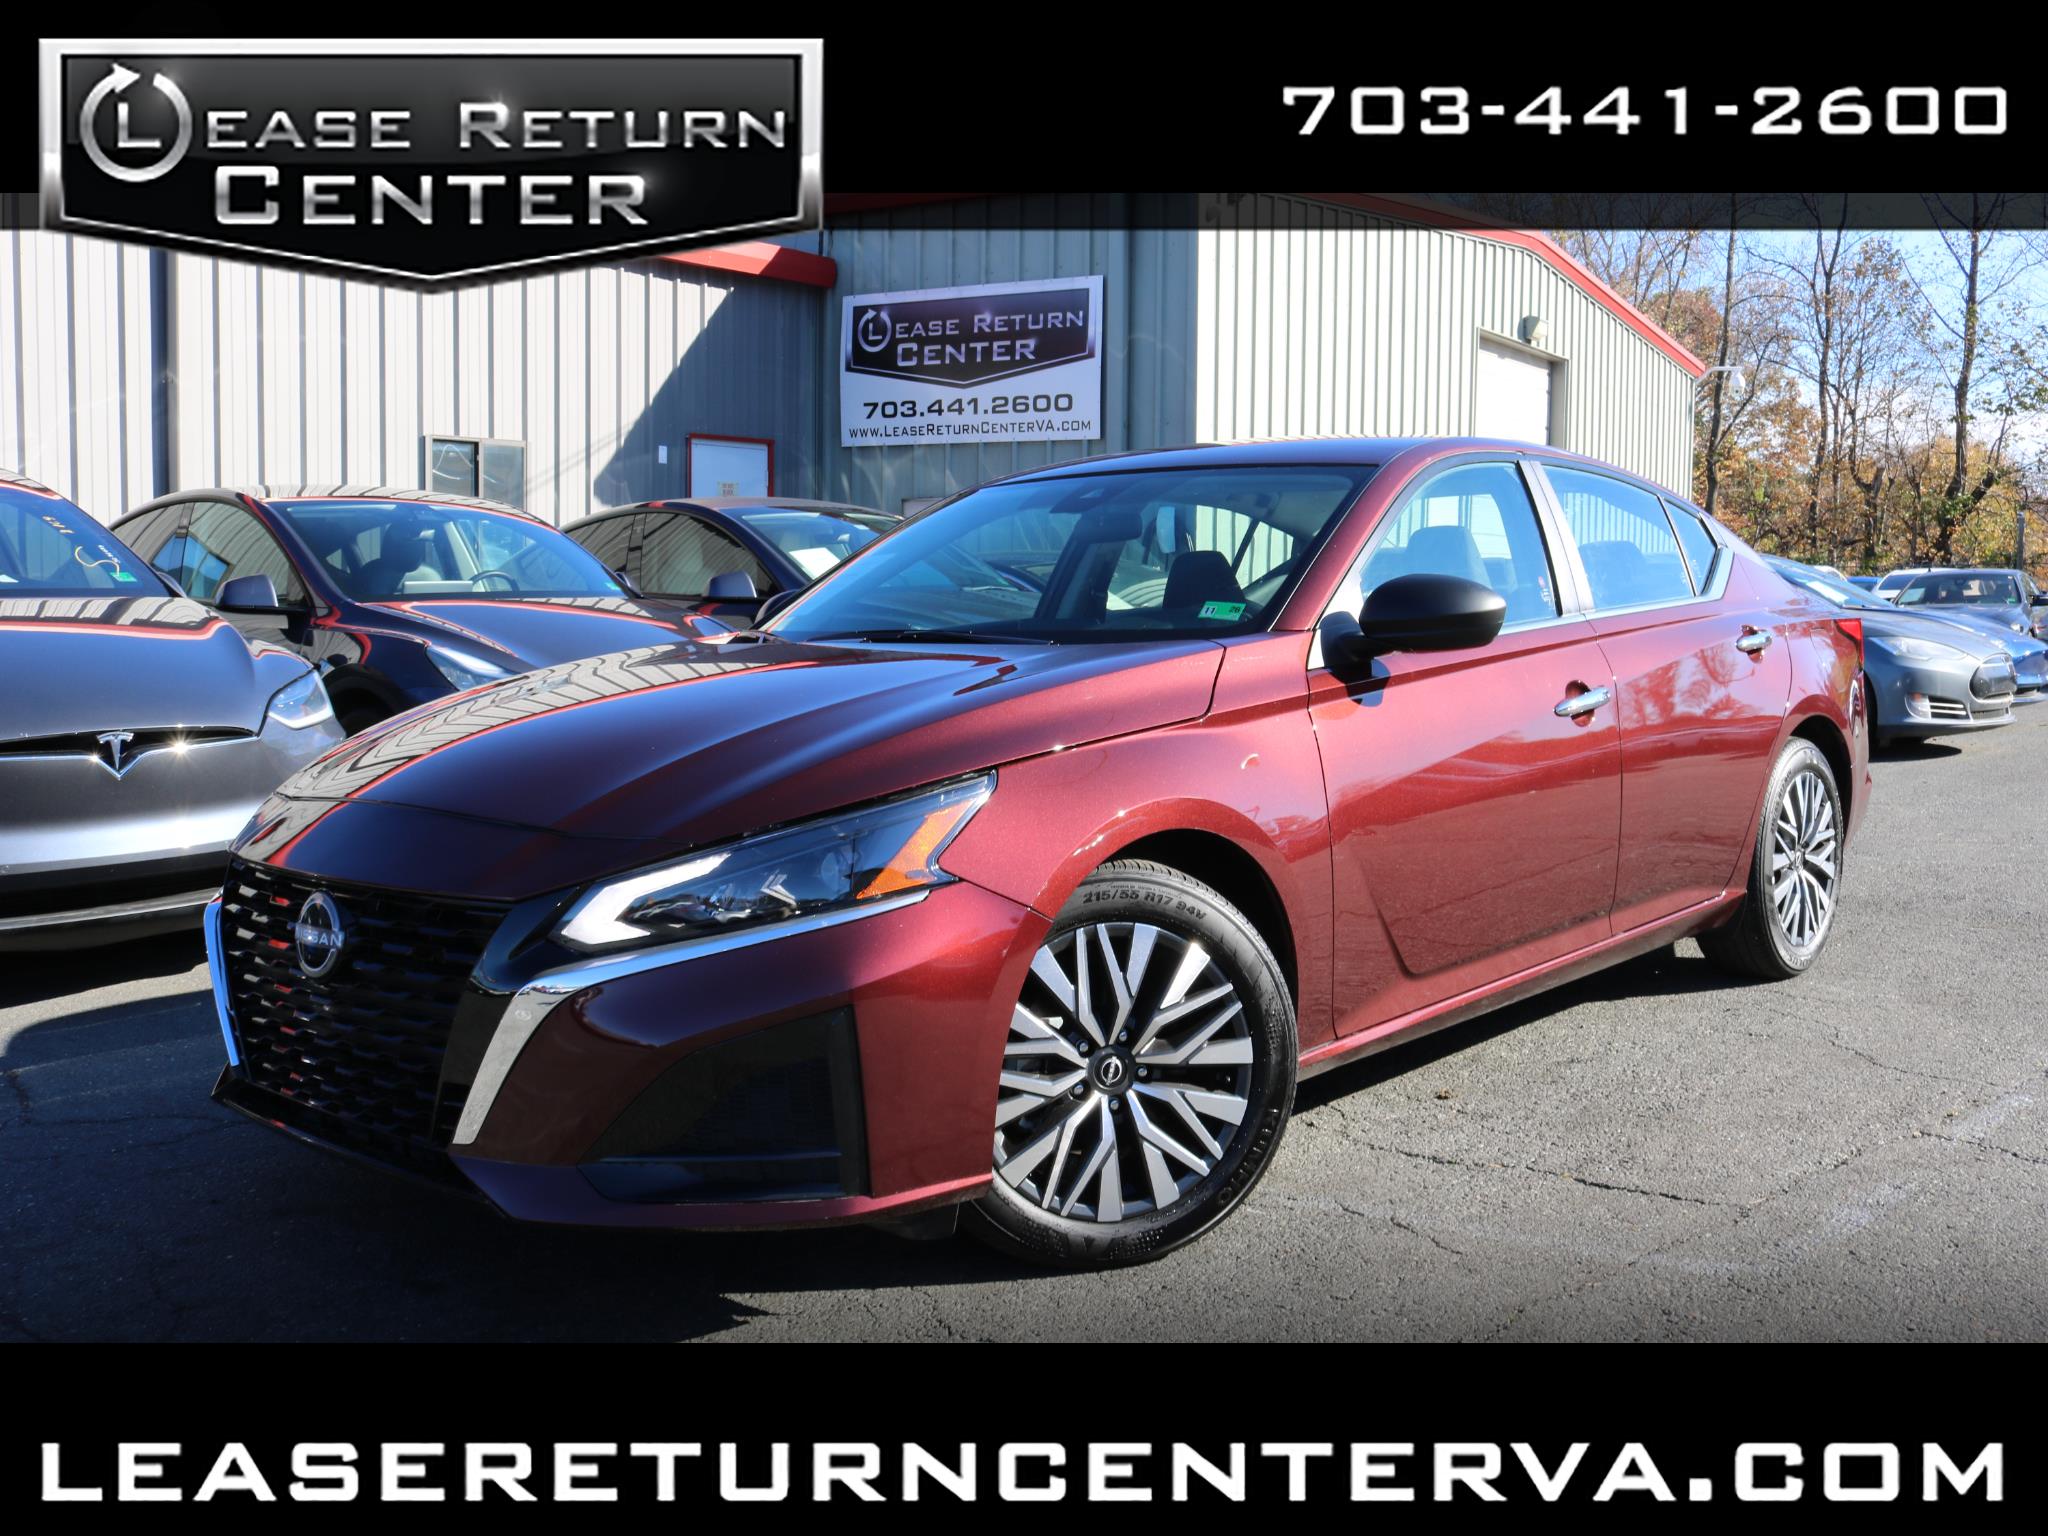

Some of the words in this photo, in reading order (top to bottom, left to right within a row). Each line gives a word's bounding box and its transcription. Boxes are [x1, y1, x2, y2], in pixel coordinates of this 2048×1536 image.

[868, 319, 960, 341] LEASE
[973, 311, 1084, 333] RETURN
[896, 339, 1036, 367] CENTER
[863, 393, 1074, 420] 703.441.2600
[1082, 889, 1140, 904] 215/55
[1143, 891, 1174, 905] R17
[1176, 900, 1207, 920] 94V
